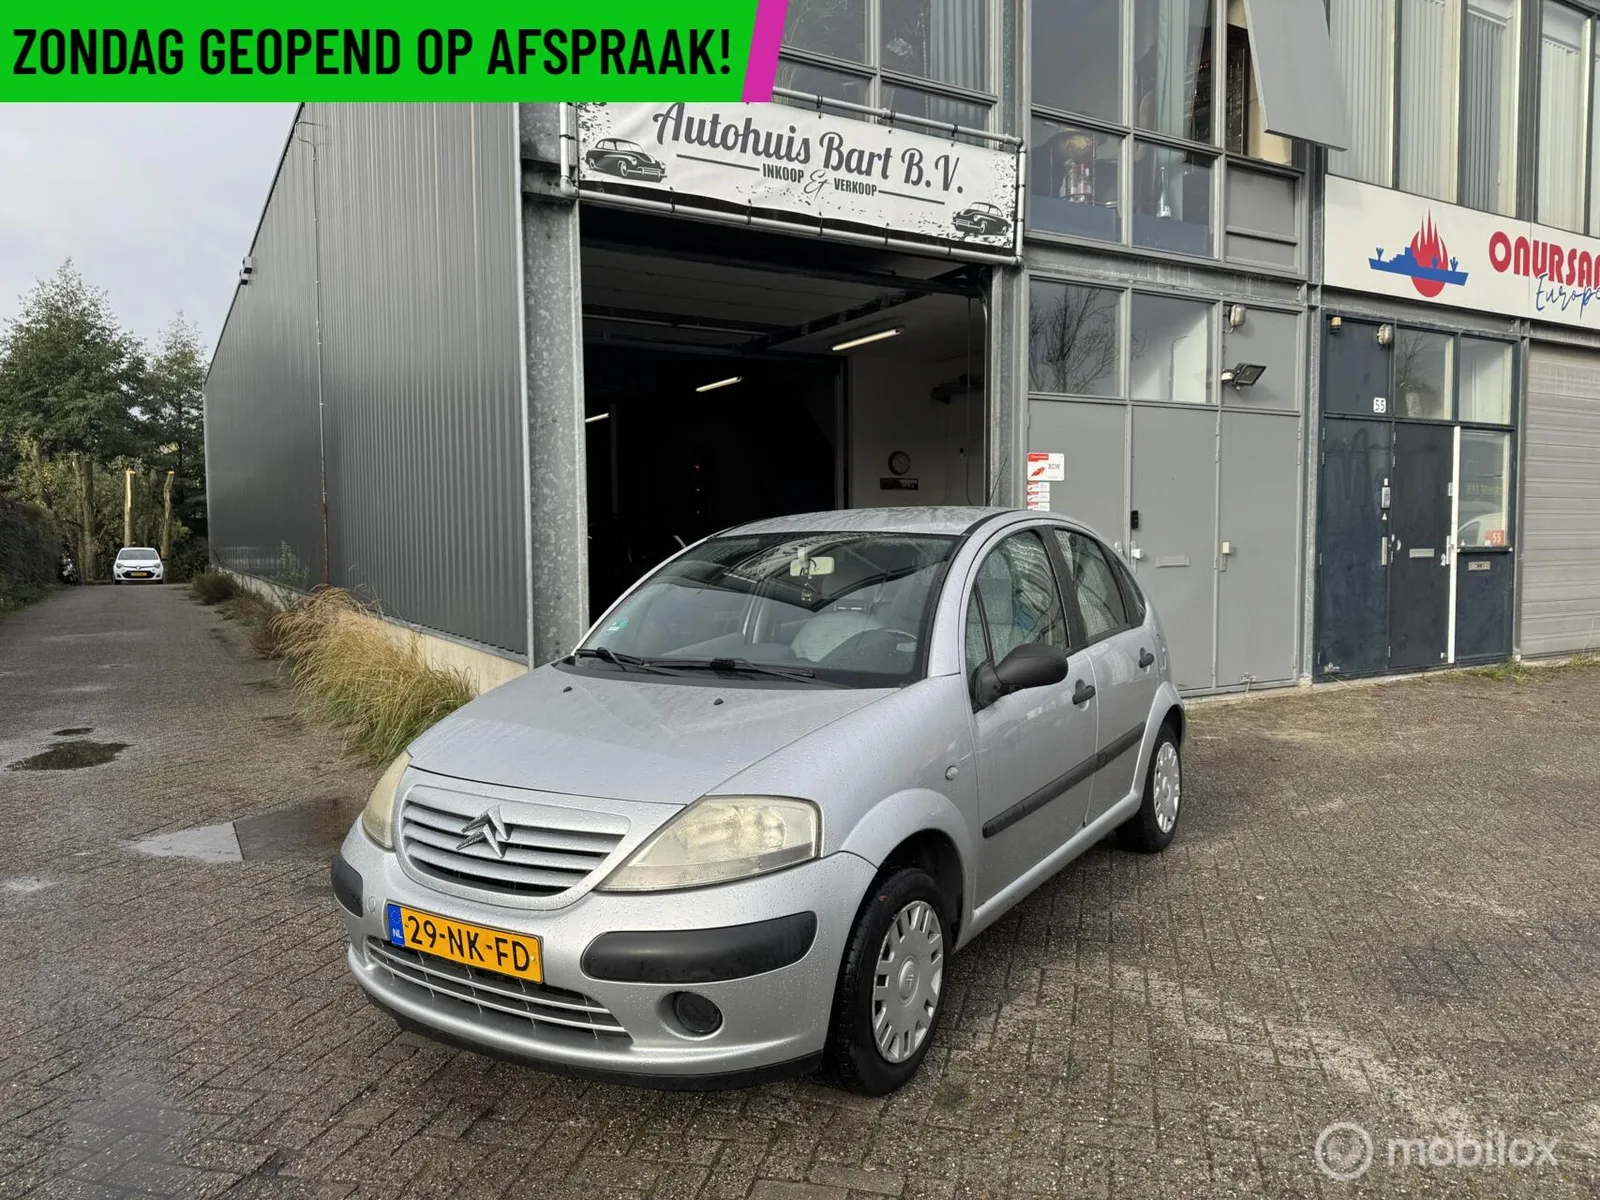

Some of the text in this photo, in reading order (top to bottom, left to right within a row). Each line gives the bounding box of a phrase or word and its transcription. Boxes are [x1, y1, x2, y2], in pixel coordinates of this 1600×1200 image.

[652, 102, 964, 194] Autohuis Bart B.V.
[762, 163, 805, 184] INKOOP
[833, 177, 878, 197] VERKOOP
[392, 927, 403, 940] NL
[407, 915, 531, 972] 29-NK-FD
